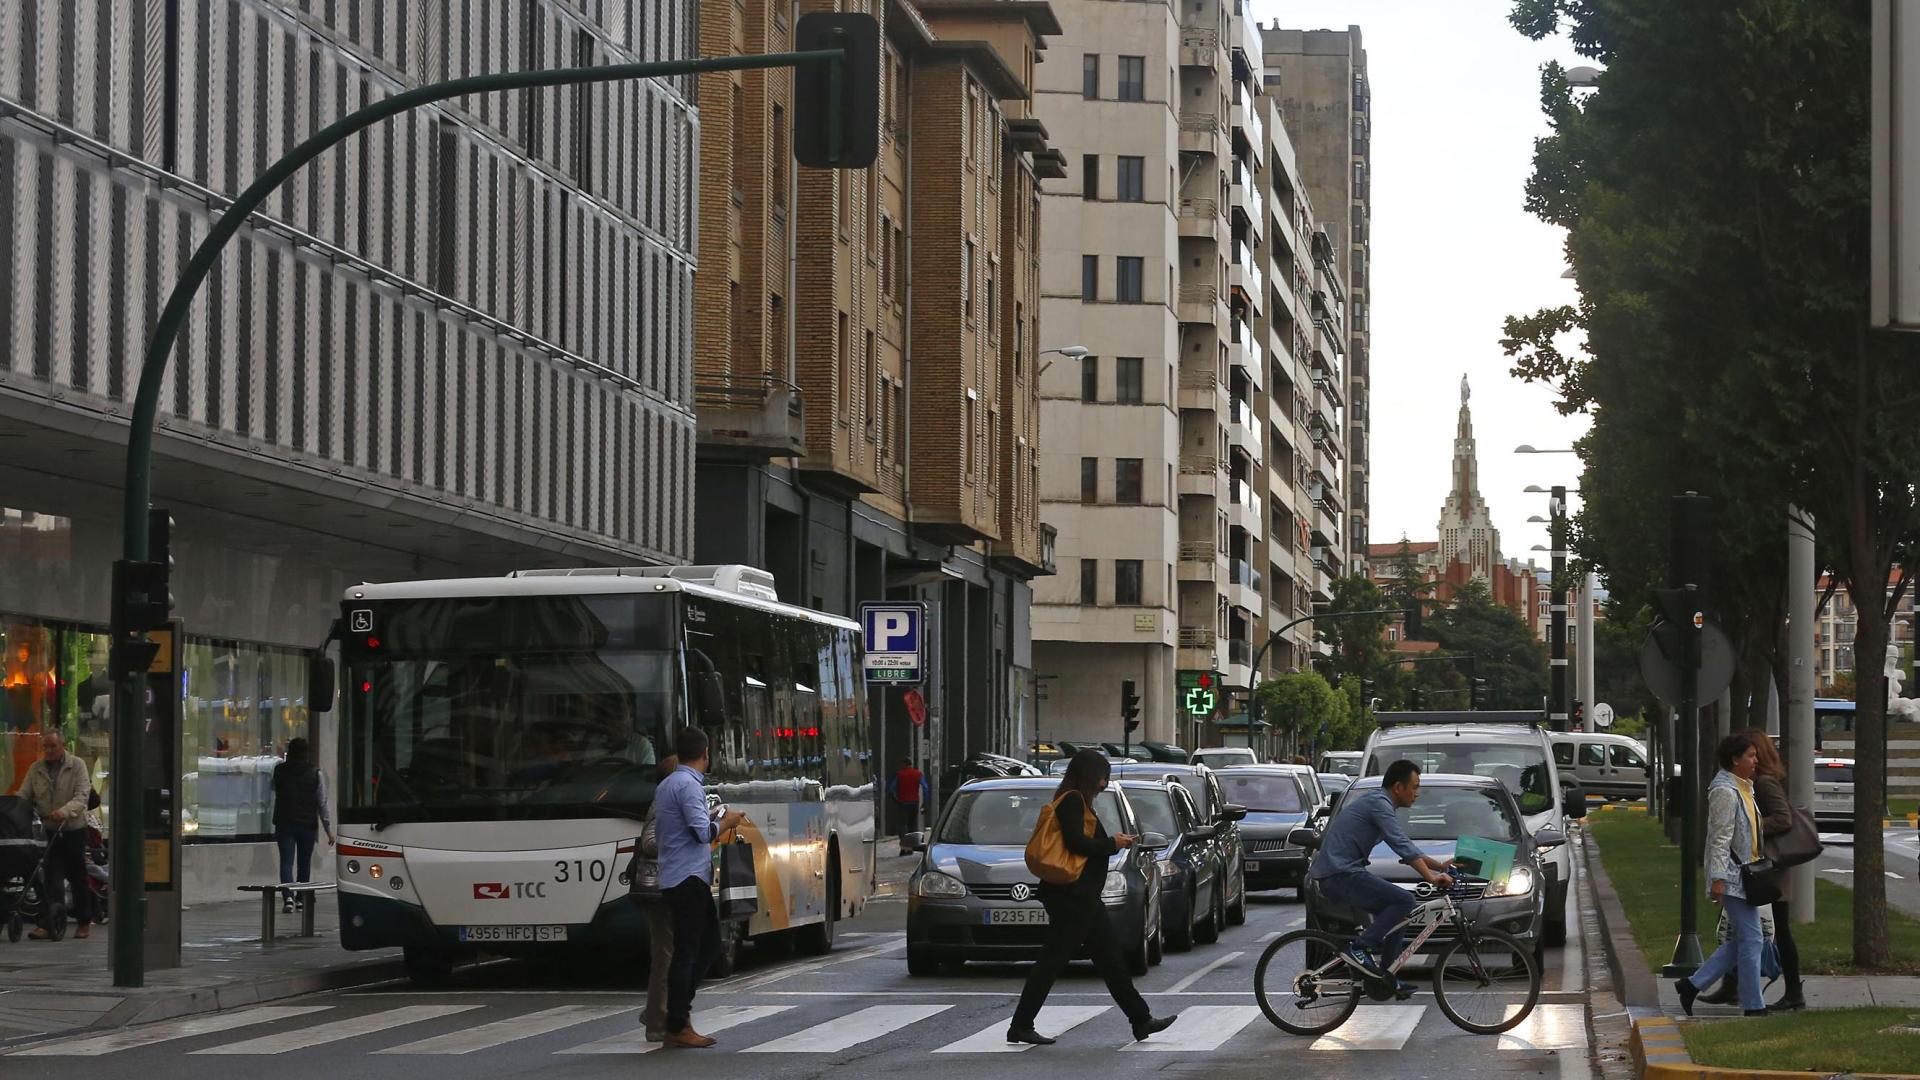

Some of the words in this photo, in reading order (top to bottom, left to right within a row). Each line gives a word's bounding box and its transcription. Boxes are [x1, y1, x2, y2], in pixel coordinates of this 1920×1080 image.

[874, 612, 909, 651] P
[877, 669, 906, 678] LIBRE
[352, 840, 389, 850] Castrosua
[554, 859, 605, 883] 310
[514, 881, 546, 899] TCC
[993, 911, 1025, 922] 8235
[1029, 911, 1047, 922] FH
[466, 926, 501, 940] 4956
[505, 926, 533, 940] HFC
